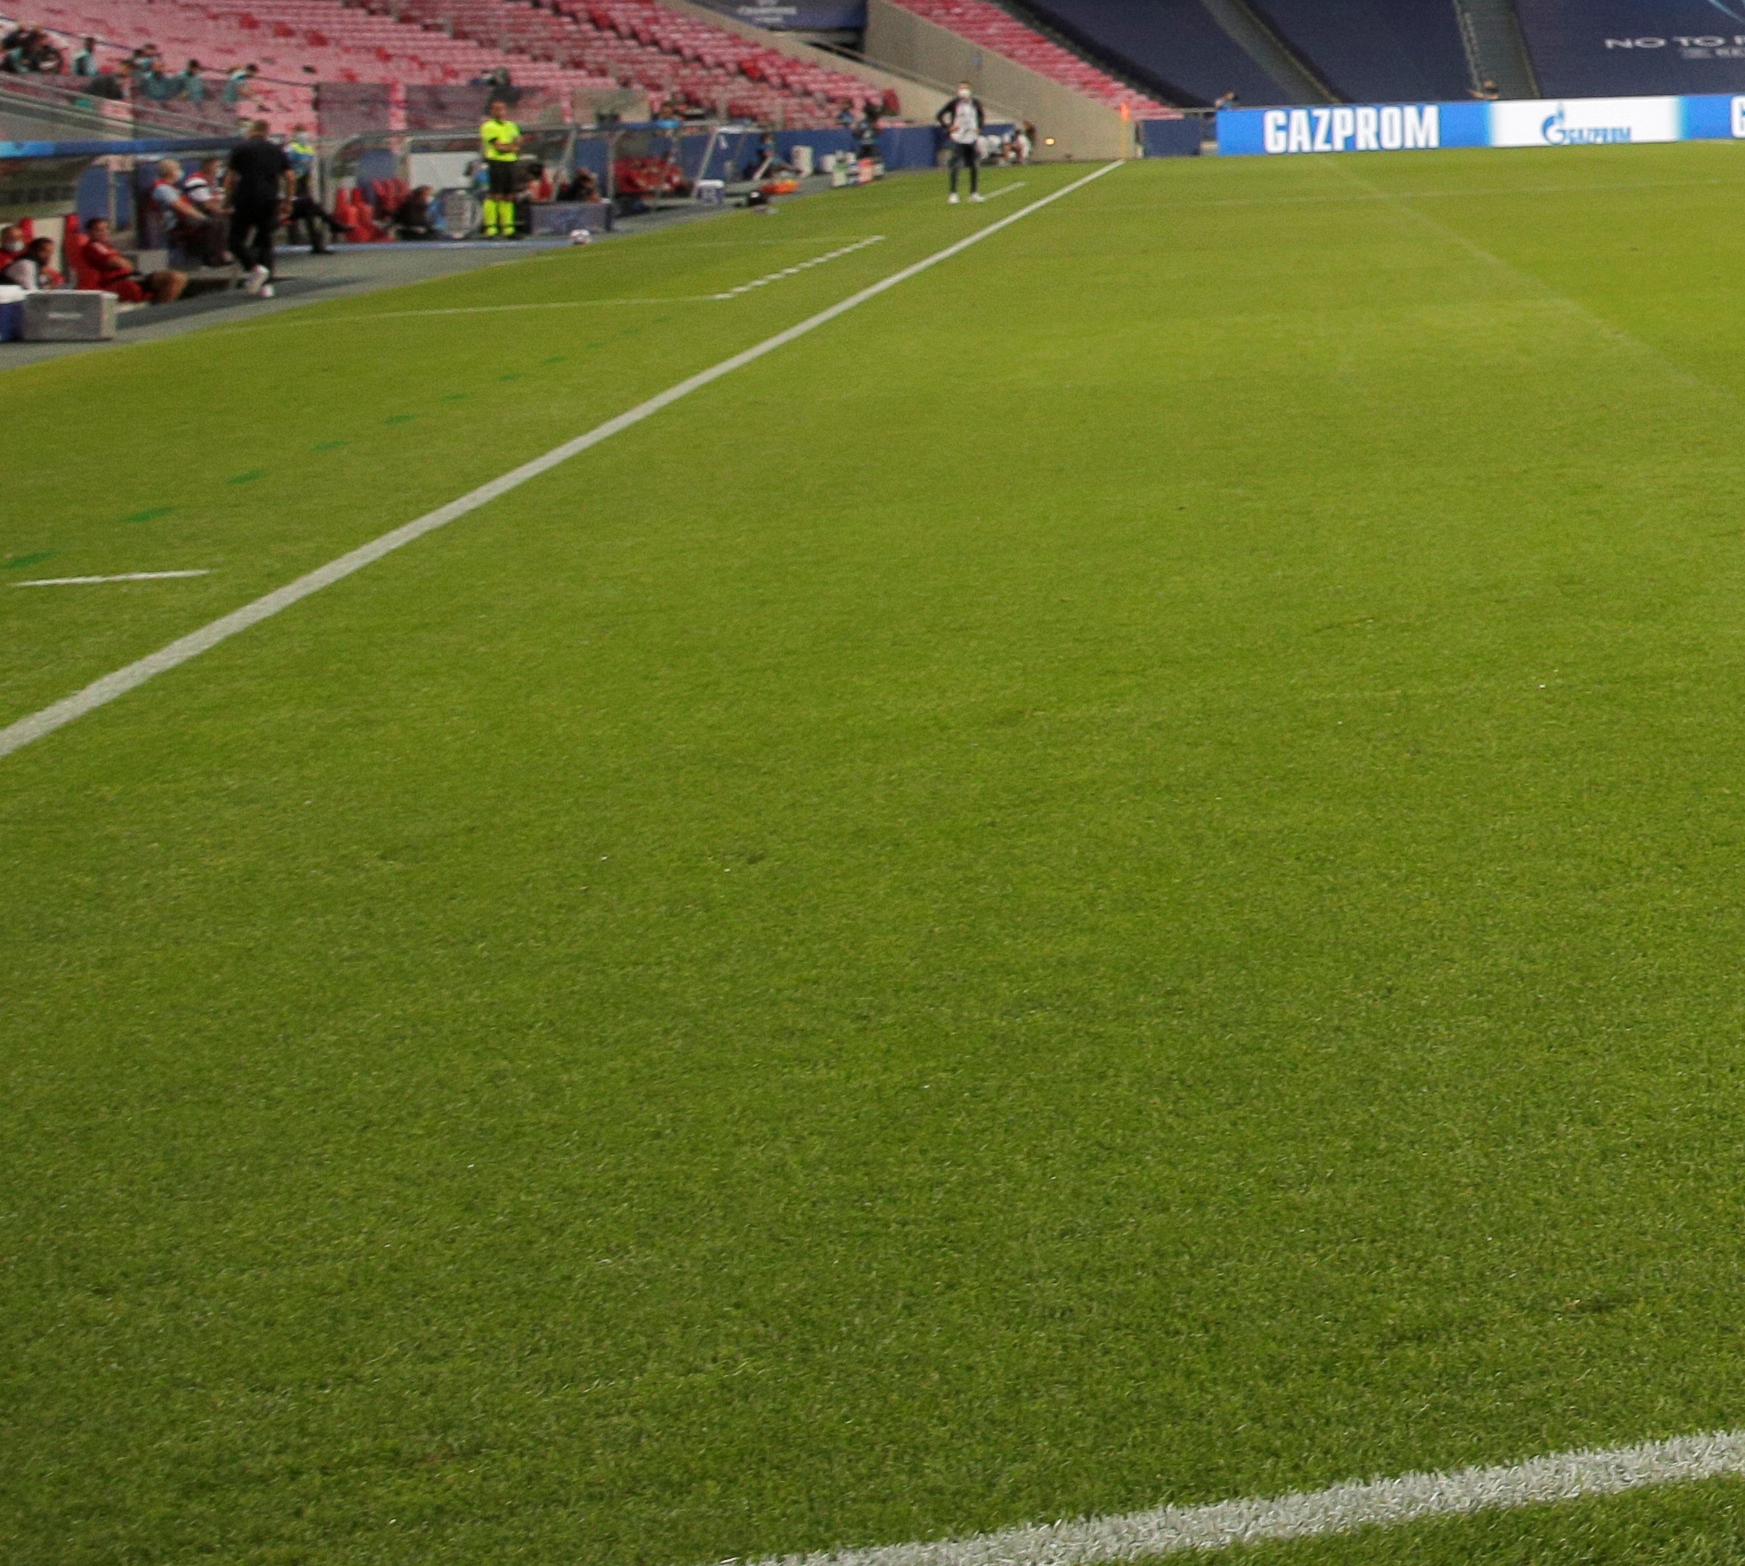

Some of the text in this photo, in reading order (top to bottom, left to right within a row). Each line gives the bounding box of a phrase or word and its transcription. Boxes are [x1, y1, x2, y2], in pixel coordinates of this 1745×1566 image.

[1604, 36, 1667, 49] NO
[1672, 35, 1725, 47] TO
[1263, 104, 1439, 154] GAZPROM
